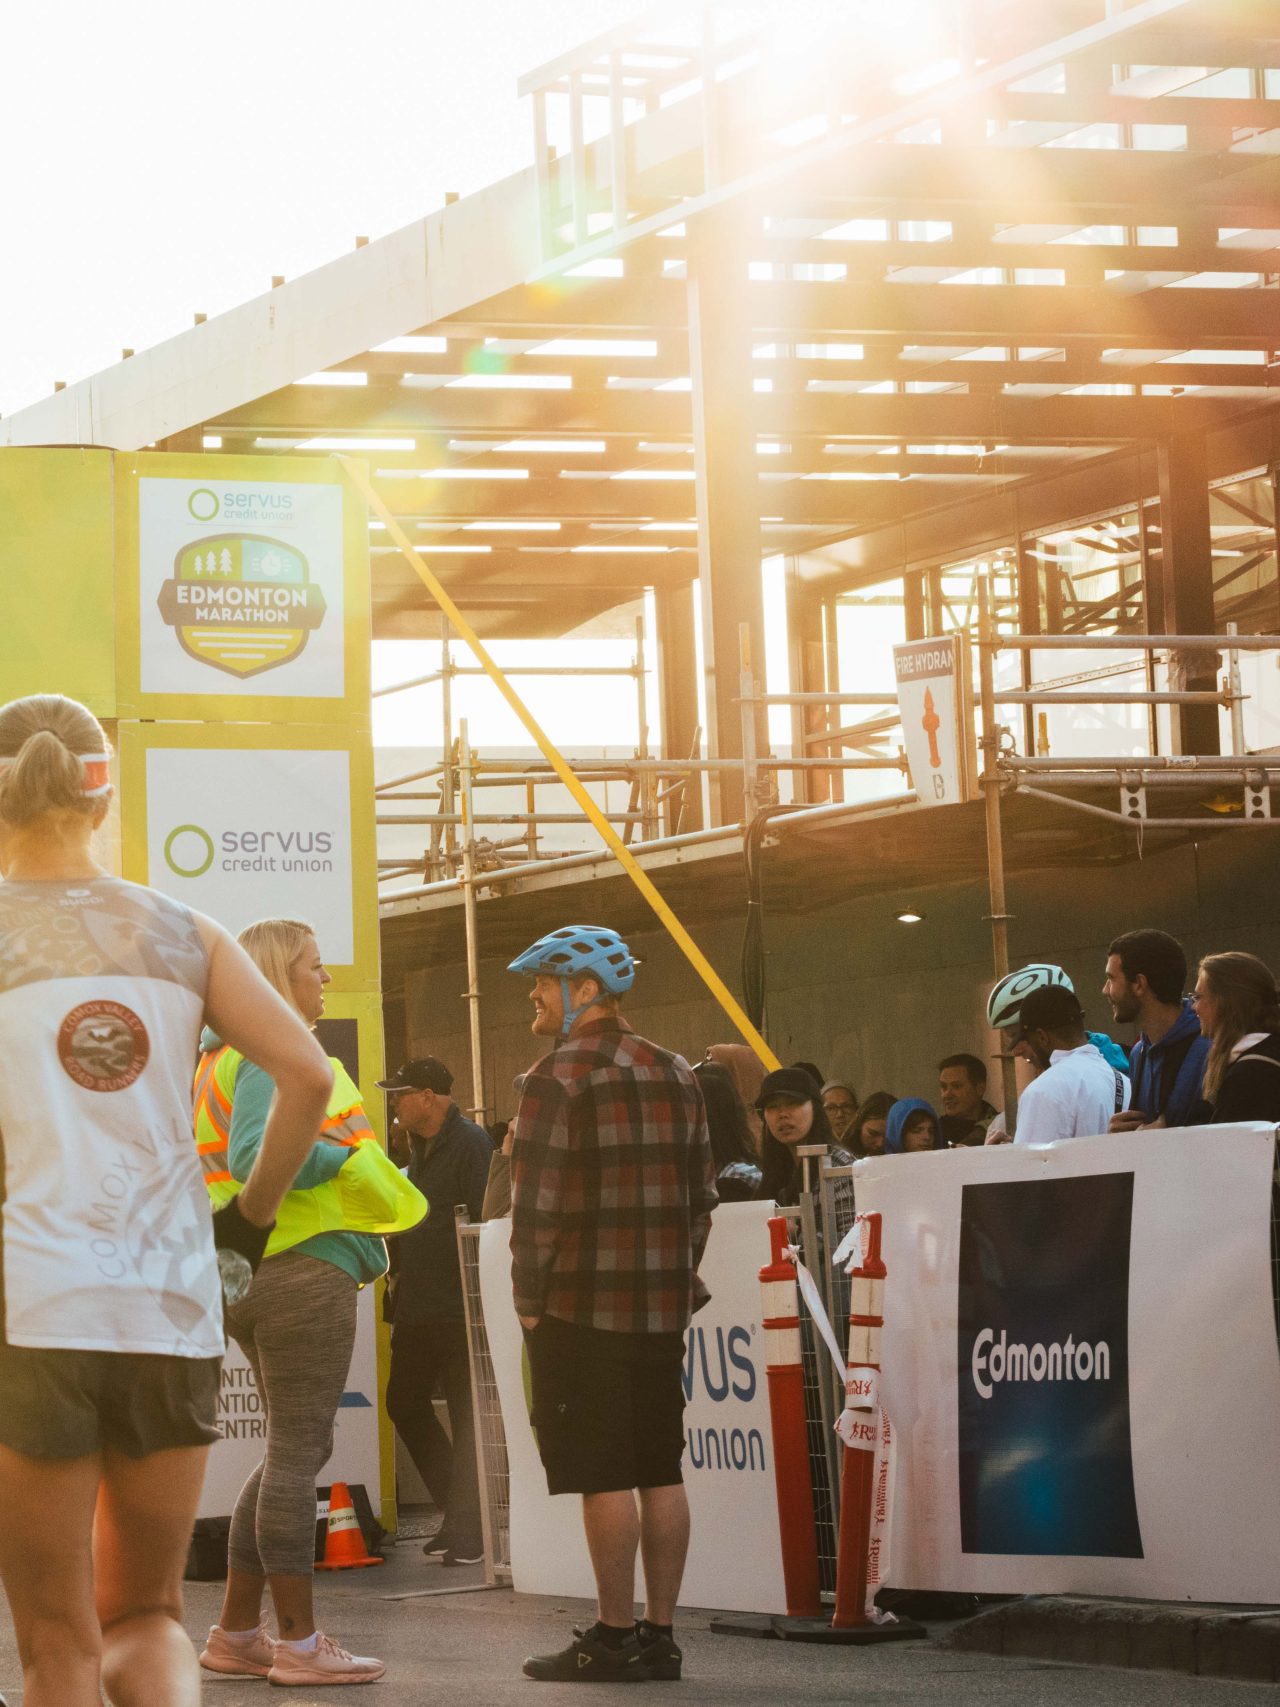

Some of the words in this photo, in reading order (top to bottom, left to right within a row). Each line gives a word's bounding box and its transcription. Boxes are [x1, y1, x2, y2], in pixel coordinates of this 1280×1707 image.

[223, 491, 293, 509] servus
[223, 507, 258, 520] credit
[261, 509, 293, 521] union
[176, 585, 308, 608] EDMONTON
[195, 607, 289, 623] MARATHON
[896, 654, 915, 675] FIRE
[221, 830, 332, 853] servus
[222, 855, 276, 872] credit
[282, 858, 333, 873] union
[972, 1327, 1110, 1399] Edmonton
[687, 1427, 766, 1472] union
